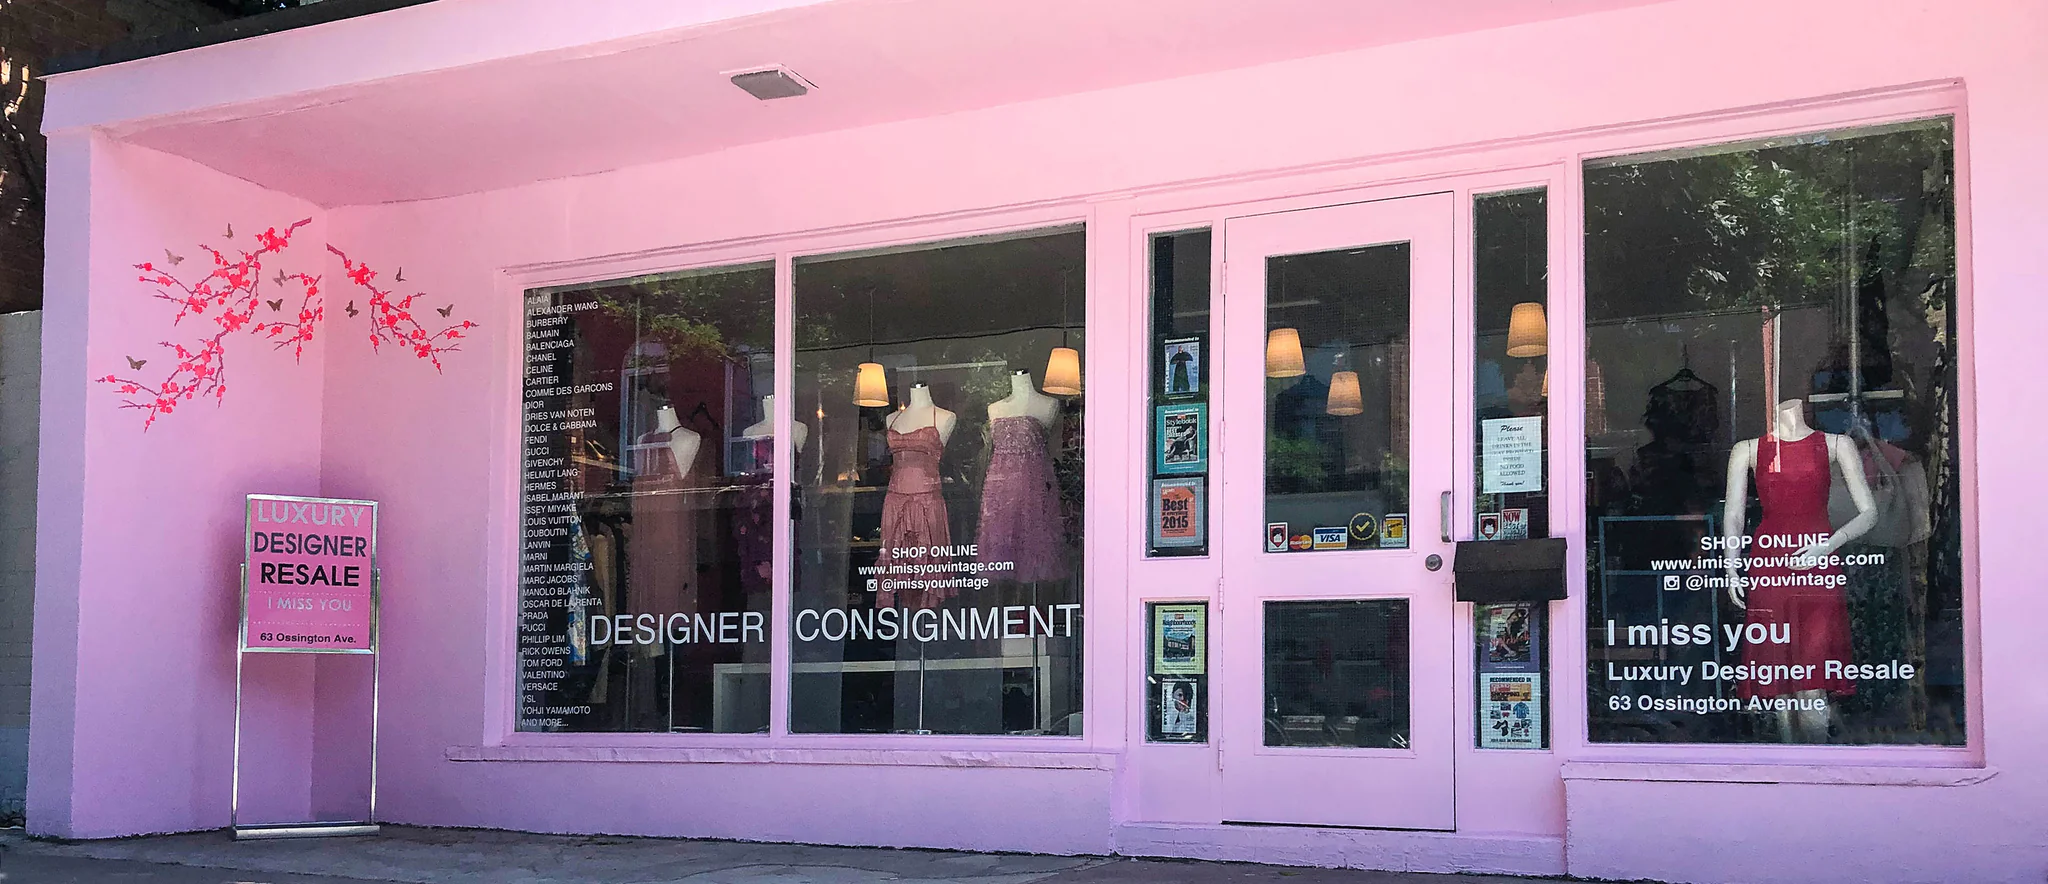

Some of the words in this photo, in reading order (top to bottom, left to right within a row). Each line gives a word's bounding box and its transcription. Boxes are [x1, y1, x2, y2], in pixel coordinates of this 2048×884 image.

[527, 296, 549, 305] ALAIA
[527, 304, 573, 316] ALEXANDER
[574, 301, 598, 311] WANG
[527, 317, 568, 328] BURBERRY
[527, 330, 559, 339] BALMAIN
[527, 340, 574, 351] BALENCIAGA
[526, 353, 557, 363] CHANEL
[526, 365, 553, 375] CELINE
[526, 376, 559, 386] CARTIER
[526, 387, 554, 398] COMME
[556, 386, 572, 395] DES
[574, 383, 613, 394] GARCONS
[525, 401, 544, 409] DIOR
[525, 411, 548, 421] DRIES
[549, 410, 566, 419] VAN
[567, 408, 594, 418] NOTEN
[525, 423, 551, 433] DOLCE
[553, 422, 558, 431] &
[560, 420, 597, 430] GABBANA
[525, 435, 547, 444] FENDI
[525, 447, 549, 456] GUCCI
[525, 458, 564, 468] GIVENCHY
[524, 469, 555, 479] HELMUT
[524, 482, 556, 491] HERMES
[524, 493, 551, 502] ISABEL
[552, 492, 584, 501] MARANT
[524, 506, 546, 515] ISSEY
[548, 503, 577, 513] MIYAKE
[1163, 498, 1188, 511] Best
[258, 501, 364, 527] LUXURY
[1503, 511, 1521, 522] NOW
[524, 517, 547, 526] LOUIS
[548, 515, 582, 525] VUITTON
[1163, 516, 1188, 528] 2015
[523, 528, 568, 537] LOUBOUTIN
[1320, 534, 1341, 542] VISA
[1701, 535, 1752, 550] SHOP
[1758, 533, 1830, 548] ONLINE
[254, 532, 367, 557] DESIGNER
[523, 541, 551, 549] LANVIN
[892, 547, 928, 559] SHOP
[931, 544, 978, 557] ONLINE
[523, 553, 547, 561] MARNI
[1651, 553, 1885, 571] www.imissyouvintage.com
[523, 564, 552, 573] MARTIN
[553, 562, 593, 571] MARGIELA
[858, 559, 1014, 577] www.imissyouvintage.com
[261, 563, 360, 586] RESALE
[523, 576, 545, 585] MARC
[547, 575, 577, 584] JACOBS
[881, 576, 989, 591] @imissyouvintage
[1686, 573, 1847, 591] @imissyouvintage
[523, 588, 556, 596] MANOLO
[557, 586, 590, 595] BLAHNIK
[268, 597, 271, 609] I
[277, 597, 313, 610] MISS
[320, 598, 352, 611] YOU
[523, 600, 550, 608] OSCAR
[552, 599, 563, 607] DE
[576, 598, 602, 607] RENTA
[522, 612, 548, 620] PRADA
[522, 624, 545, 632] PUCCI
[591, 612, 765, 646] DESIGNER
[795, 604, 1081, 642] CONSIGNMENT
[260, 633, 273, 641] 63
[277, 633, 330, 644] Ossington
[334, 635, 356, 643] Ave.
[522, 635, 550, 643] PHILLIP
[1608, 620, 1615, 645] I
[1628, 619, 1711, 645] miss
[1724, 622, 1791, 651] you
[522, 647, 540, 655] RICK
[541, 646, 571, 655] OWENS
[522, 659, 539, 667] TOM
[541, 659, 562, 667] FORD
[522, 670, 565, 679] VALENTINO
[1608, 663, 1693, 685] Luxury
[1702, 661, 1815, 685] Designer
[1825, 660, 1915, 680] Resale
[522, 683, 558, 691] VERSACE
[522, 695, 536, 703] YSL
[1608, 696, 1631, 710] 63
[1637, 695, 1741, 714] Ossington
[1748, 695, 1825, 711] Avenue
[521, 707, 544, 715] YOHJI
[546, 706, 590, 714] YAMAMOTO
[521, 719, 538, 727] AND
[539, 718, 569, 727] MORE...
